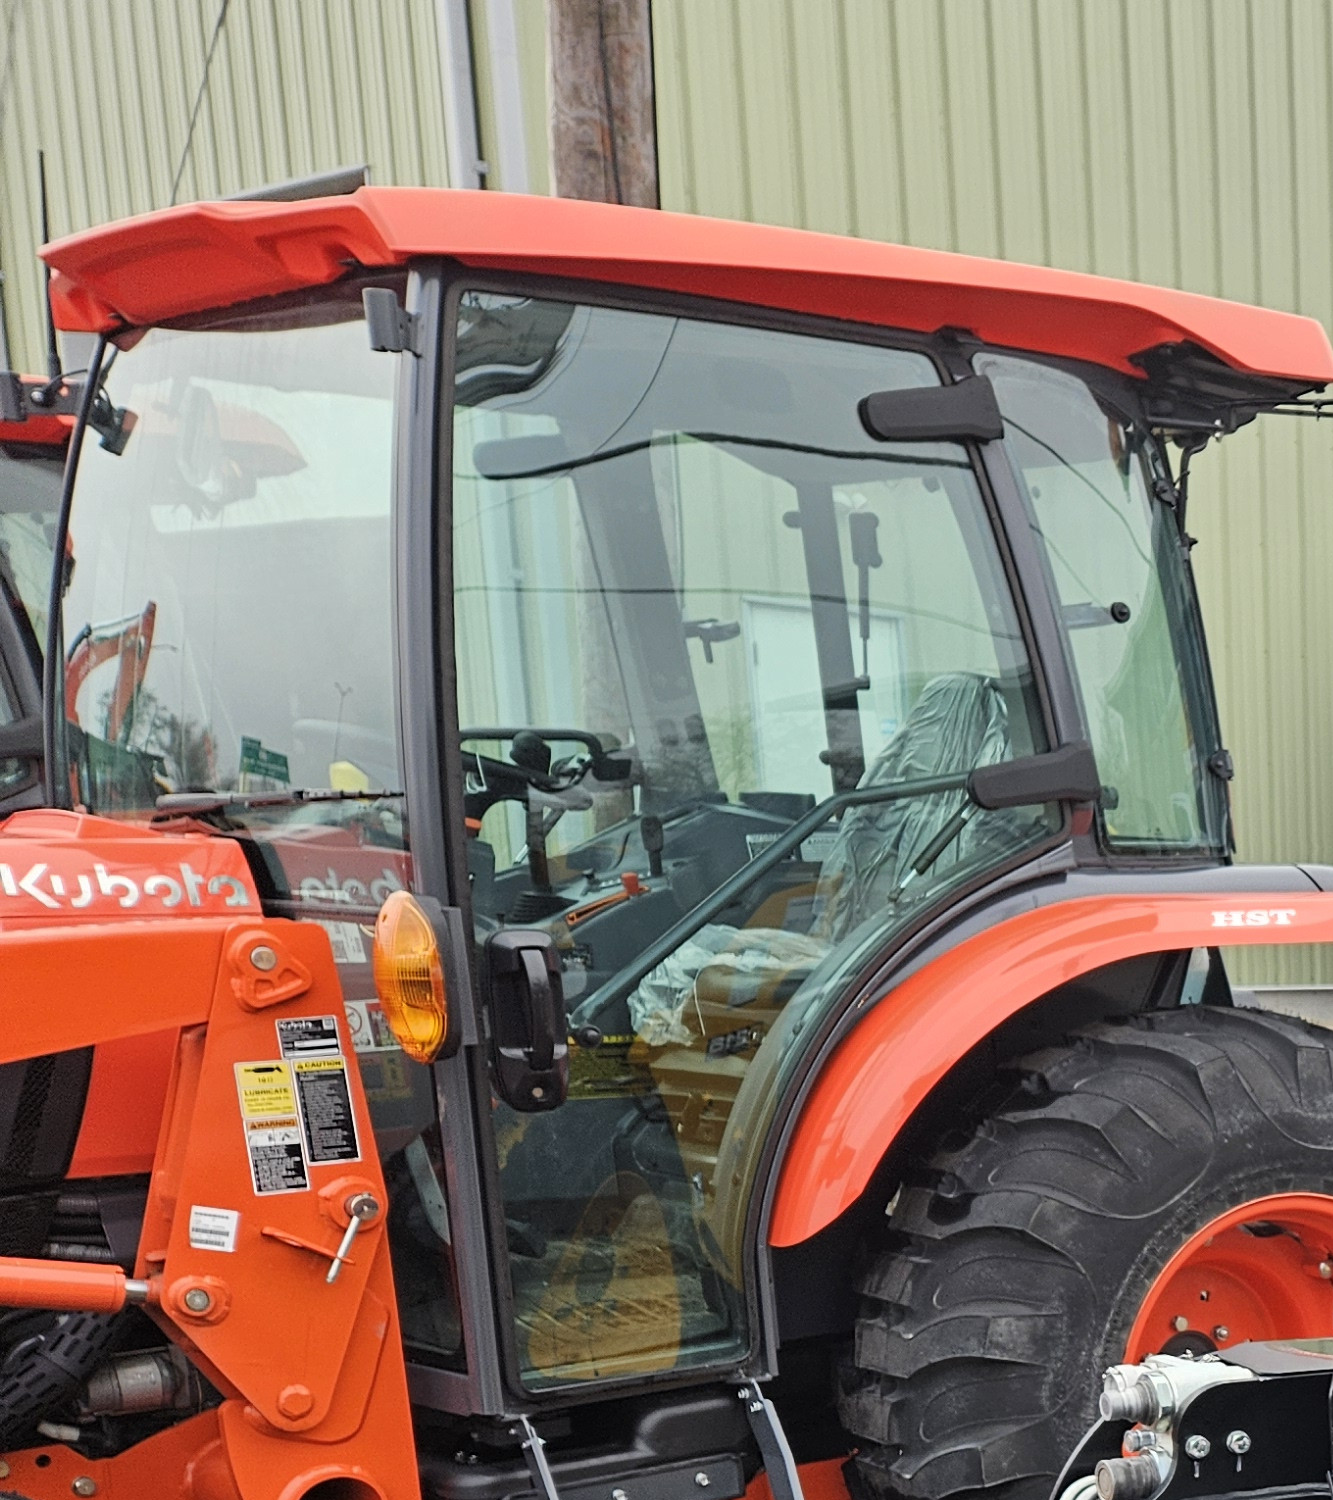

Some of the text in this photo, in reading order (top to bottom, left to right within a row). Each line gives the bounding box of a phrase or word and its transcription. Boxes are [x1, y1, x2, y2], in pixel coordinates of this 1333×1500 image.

[0, 862, 250, 909] Kubota
[1211, 909, 1296, 928] HST
[304, 1060, 341, 1069] CAUTION
